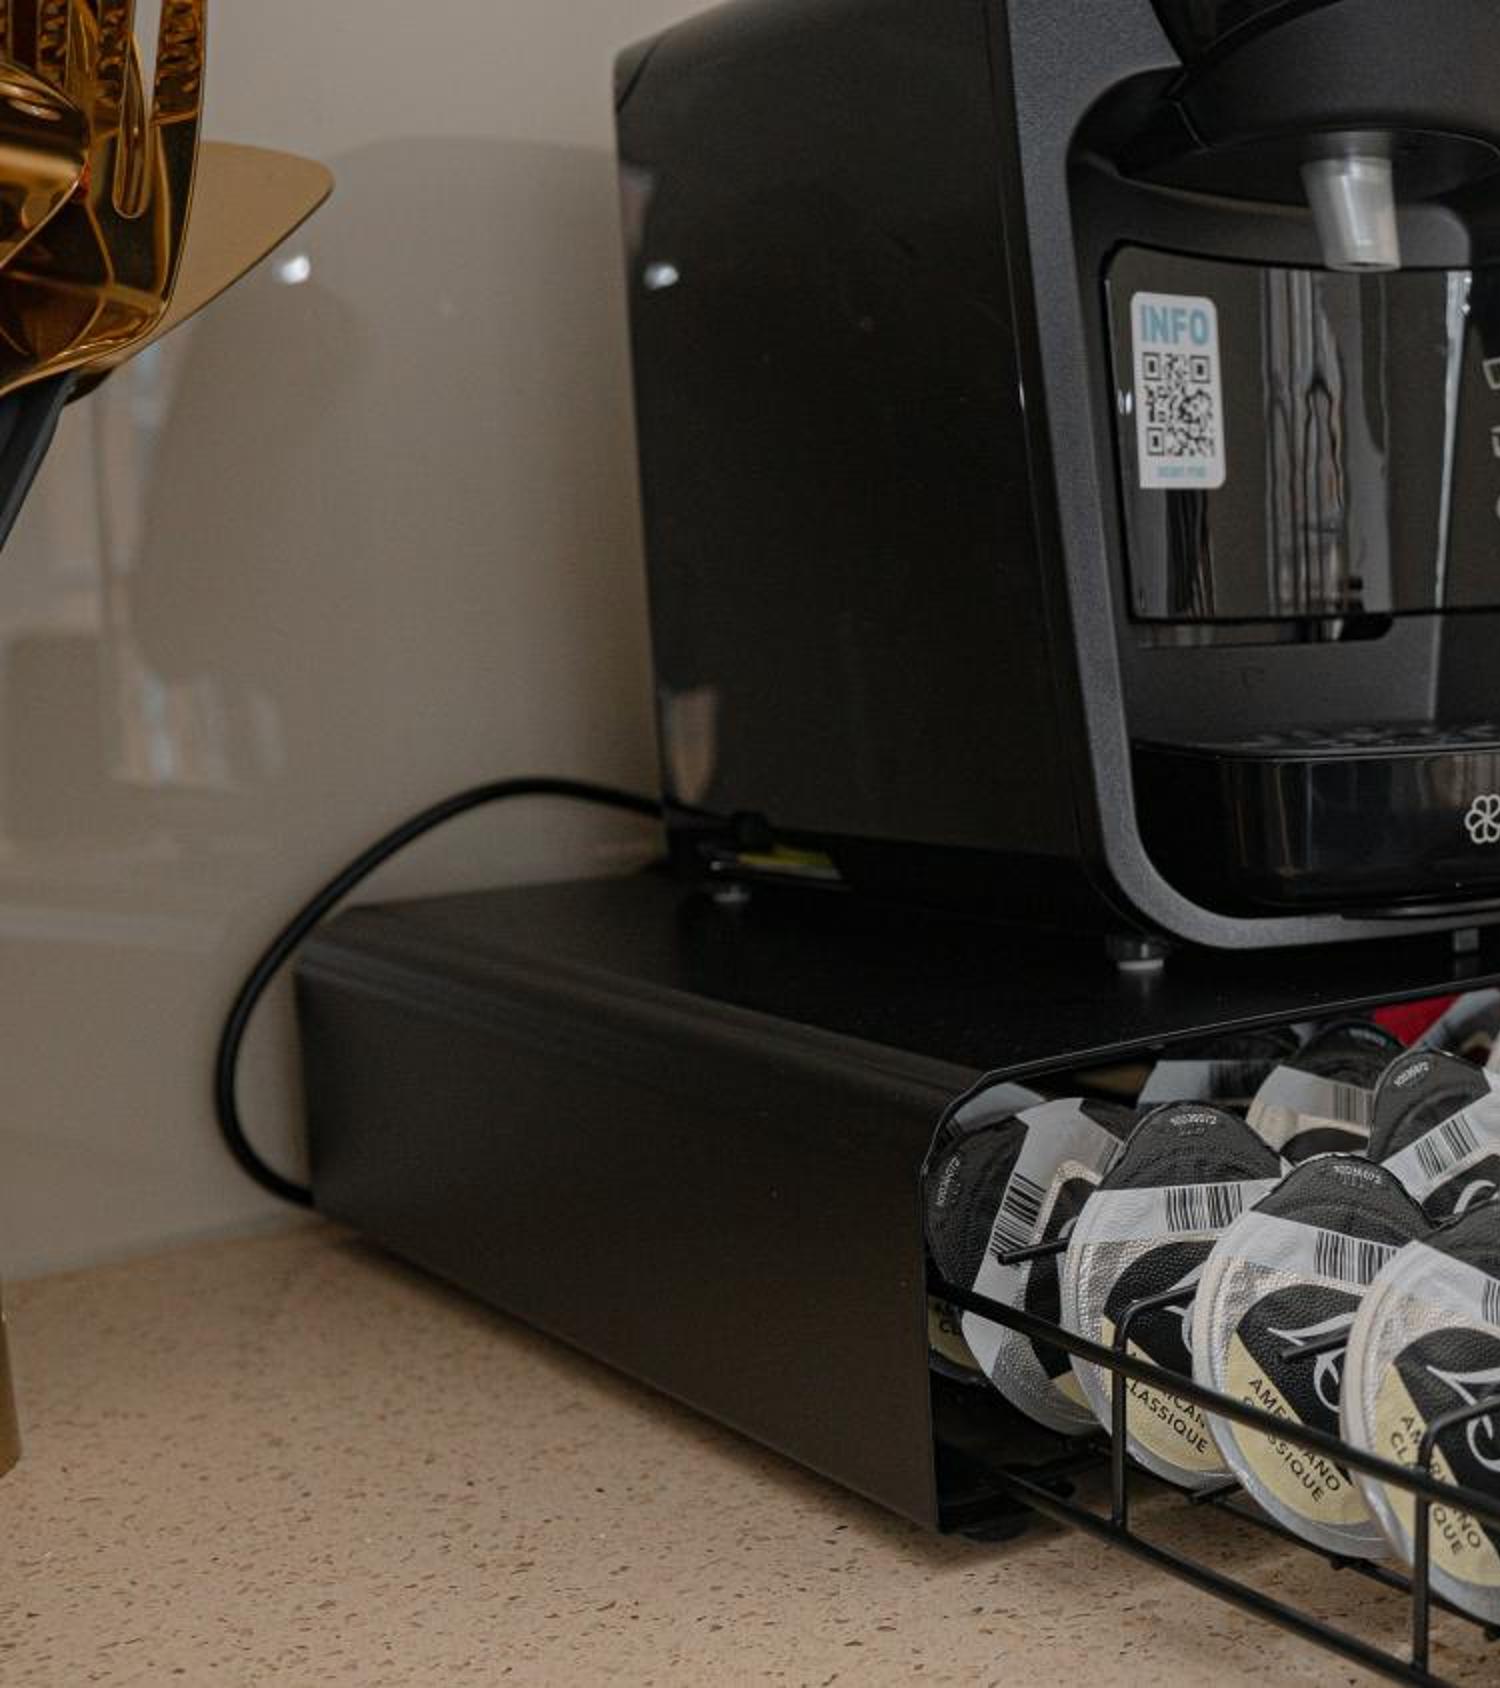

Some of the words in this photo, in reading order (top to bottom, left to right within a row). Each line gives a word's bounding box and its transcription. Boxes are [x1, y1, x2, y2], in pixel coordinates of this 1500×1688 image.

[1141, 305, 1209, 345] INFO
[1127, 1381, 1208, 1453] LASSIQUE
[1391, 1431, 1463, 1556] CLQUE
